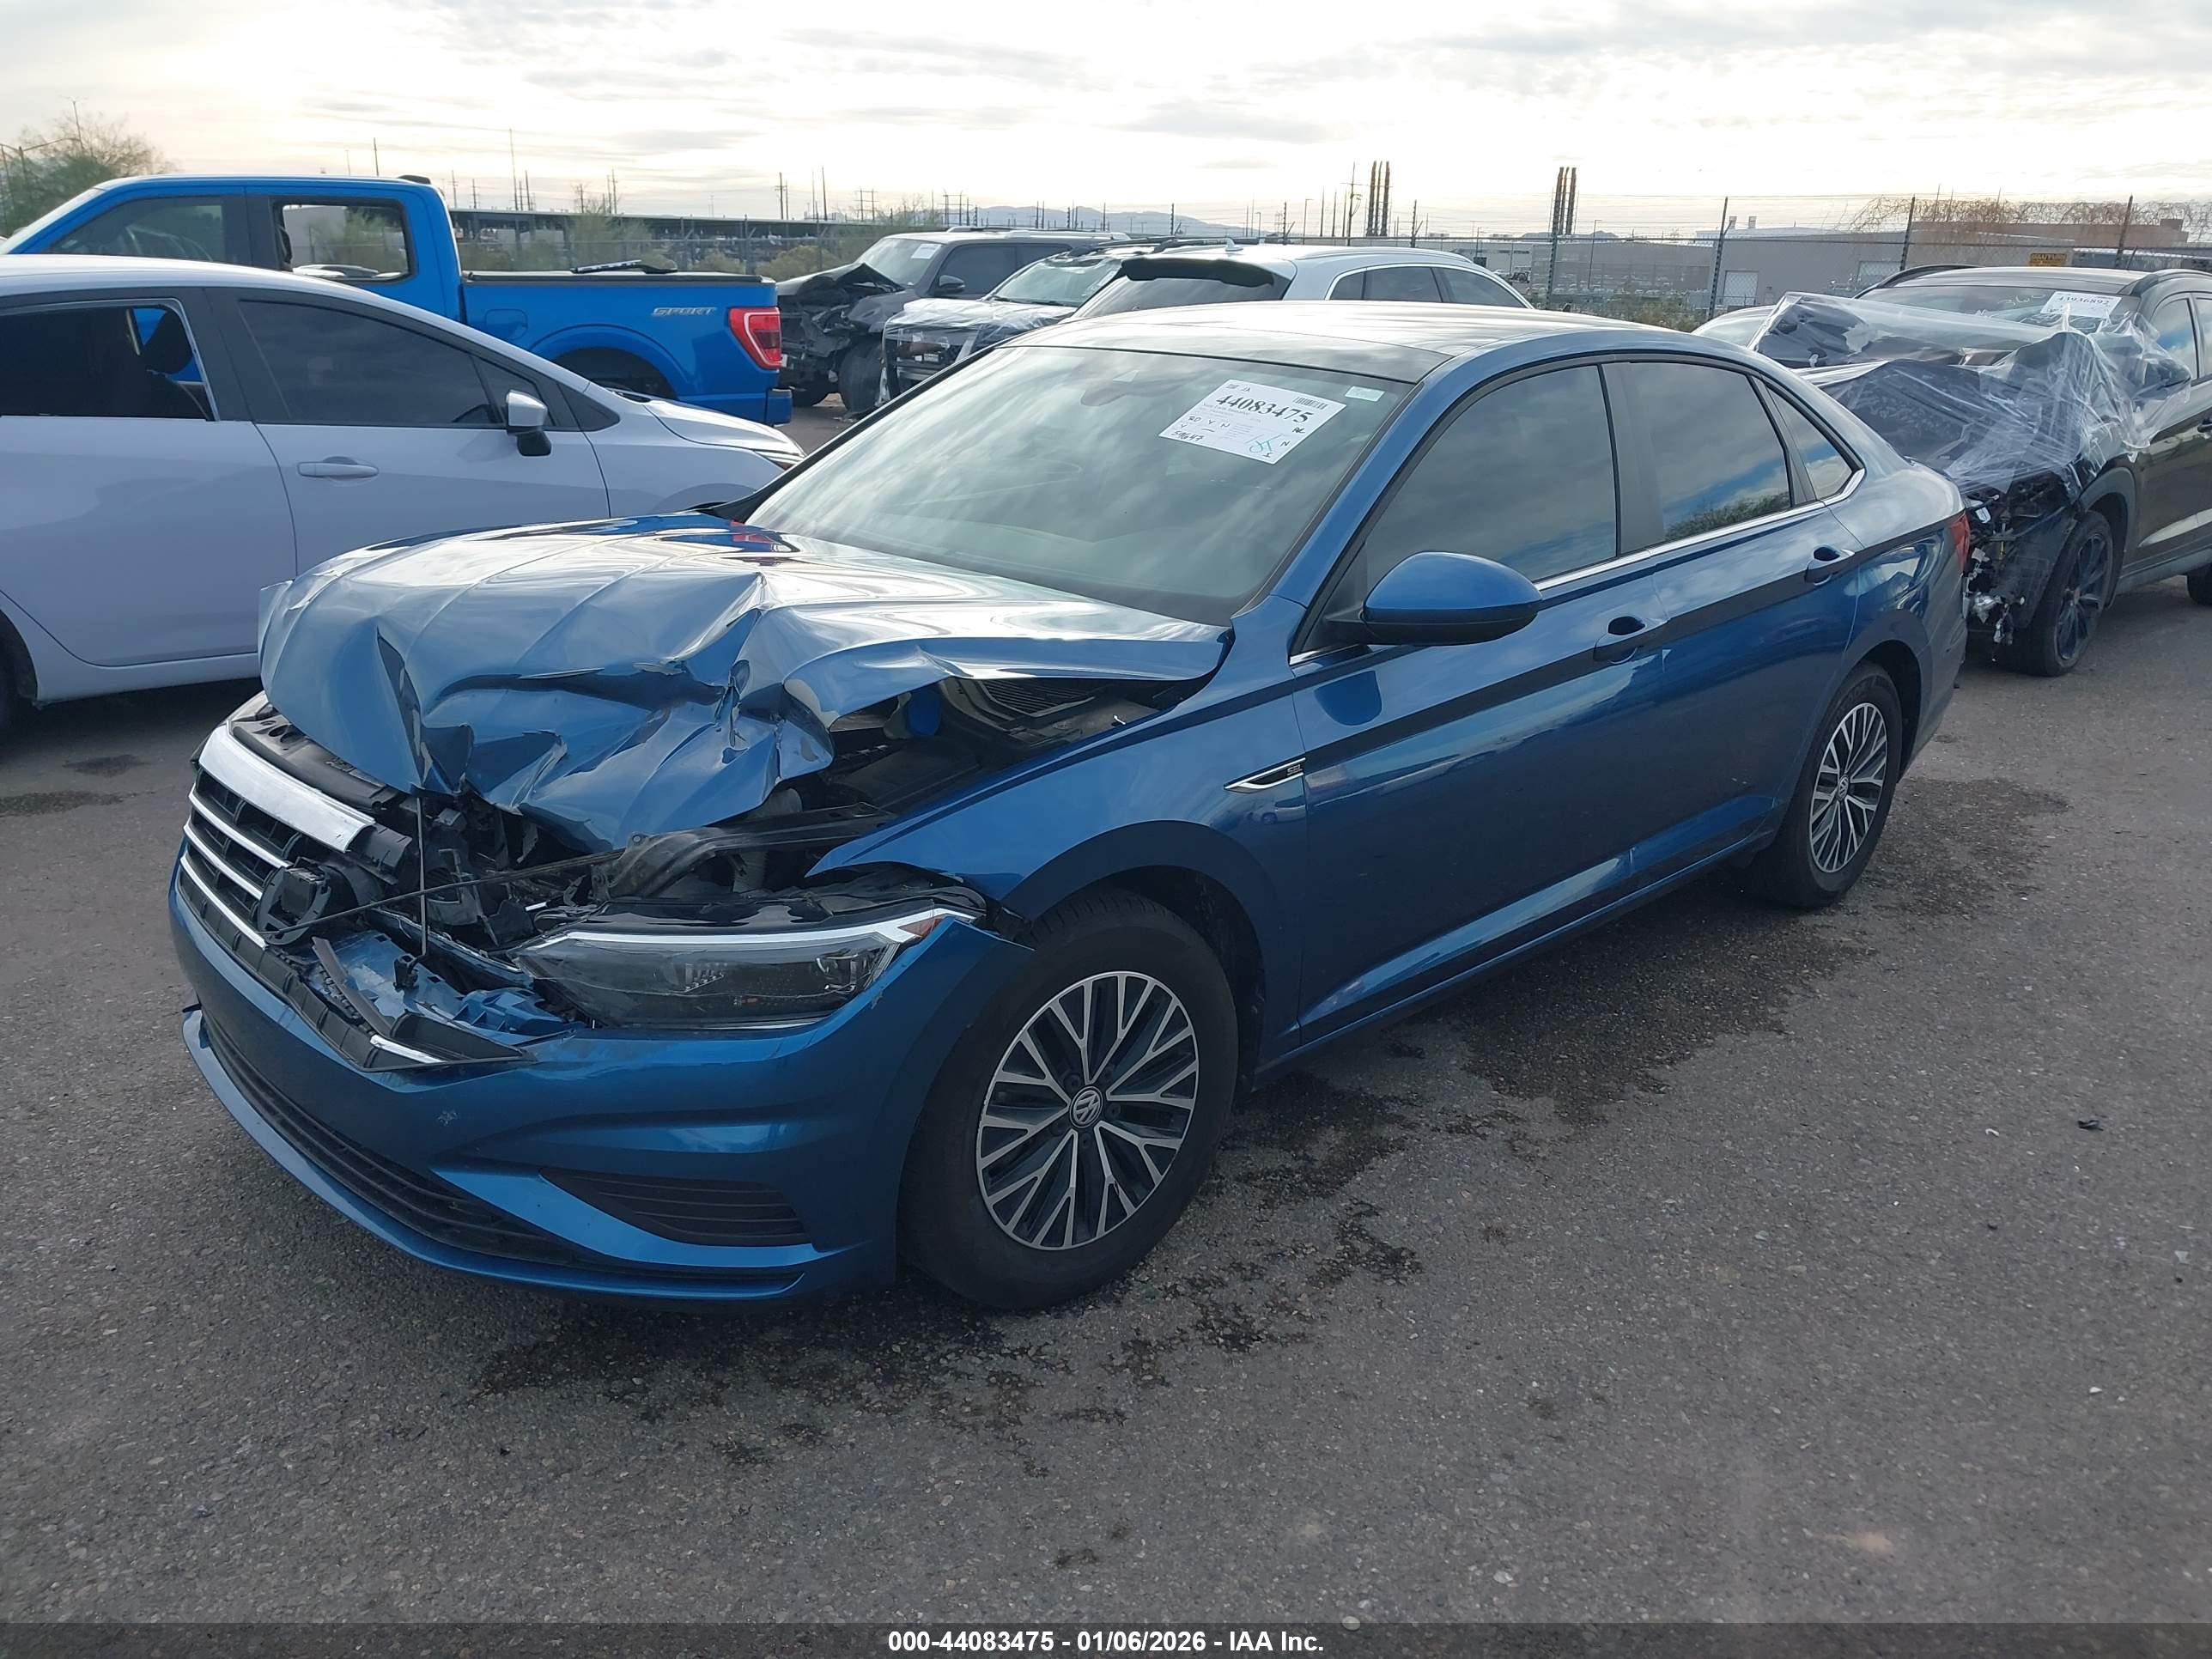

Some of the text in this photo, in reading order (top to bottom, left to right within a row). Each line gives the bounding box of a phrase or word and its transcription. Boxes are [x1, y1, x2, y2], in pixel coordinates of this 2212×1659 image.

[652, 307, 717, 317] SPORT
[1216, 394, 1314, 423] 44083475
[1286, 764, 1303, 775] SEL
